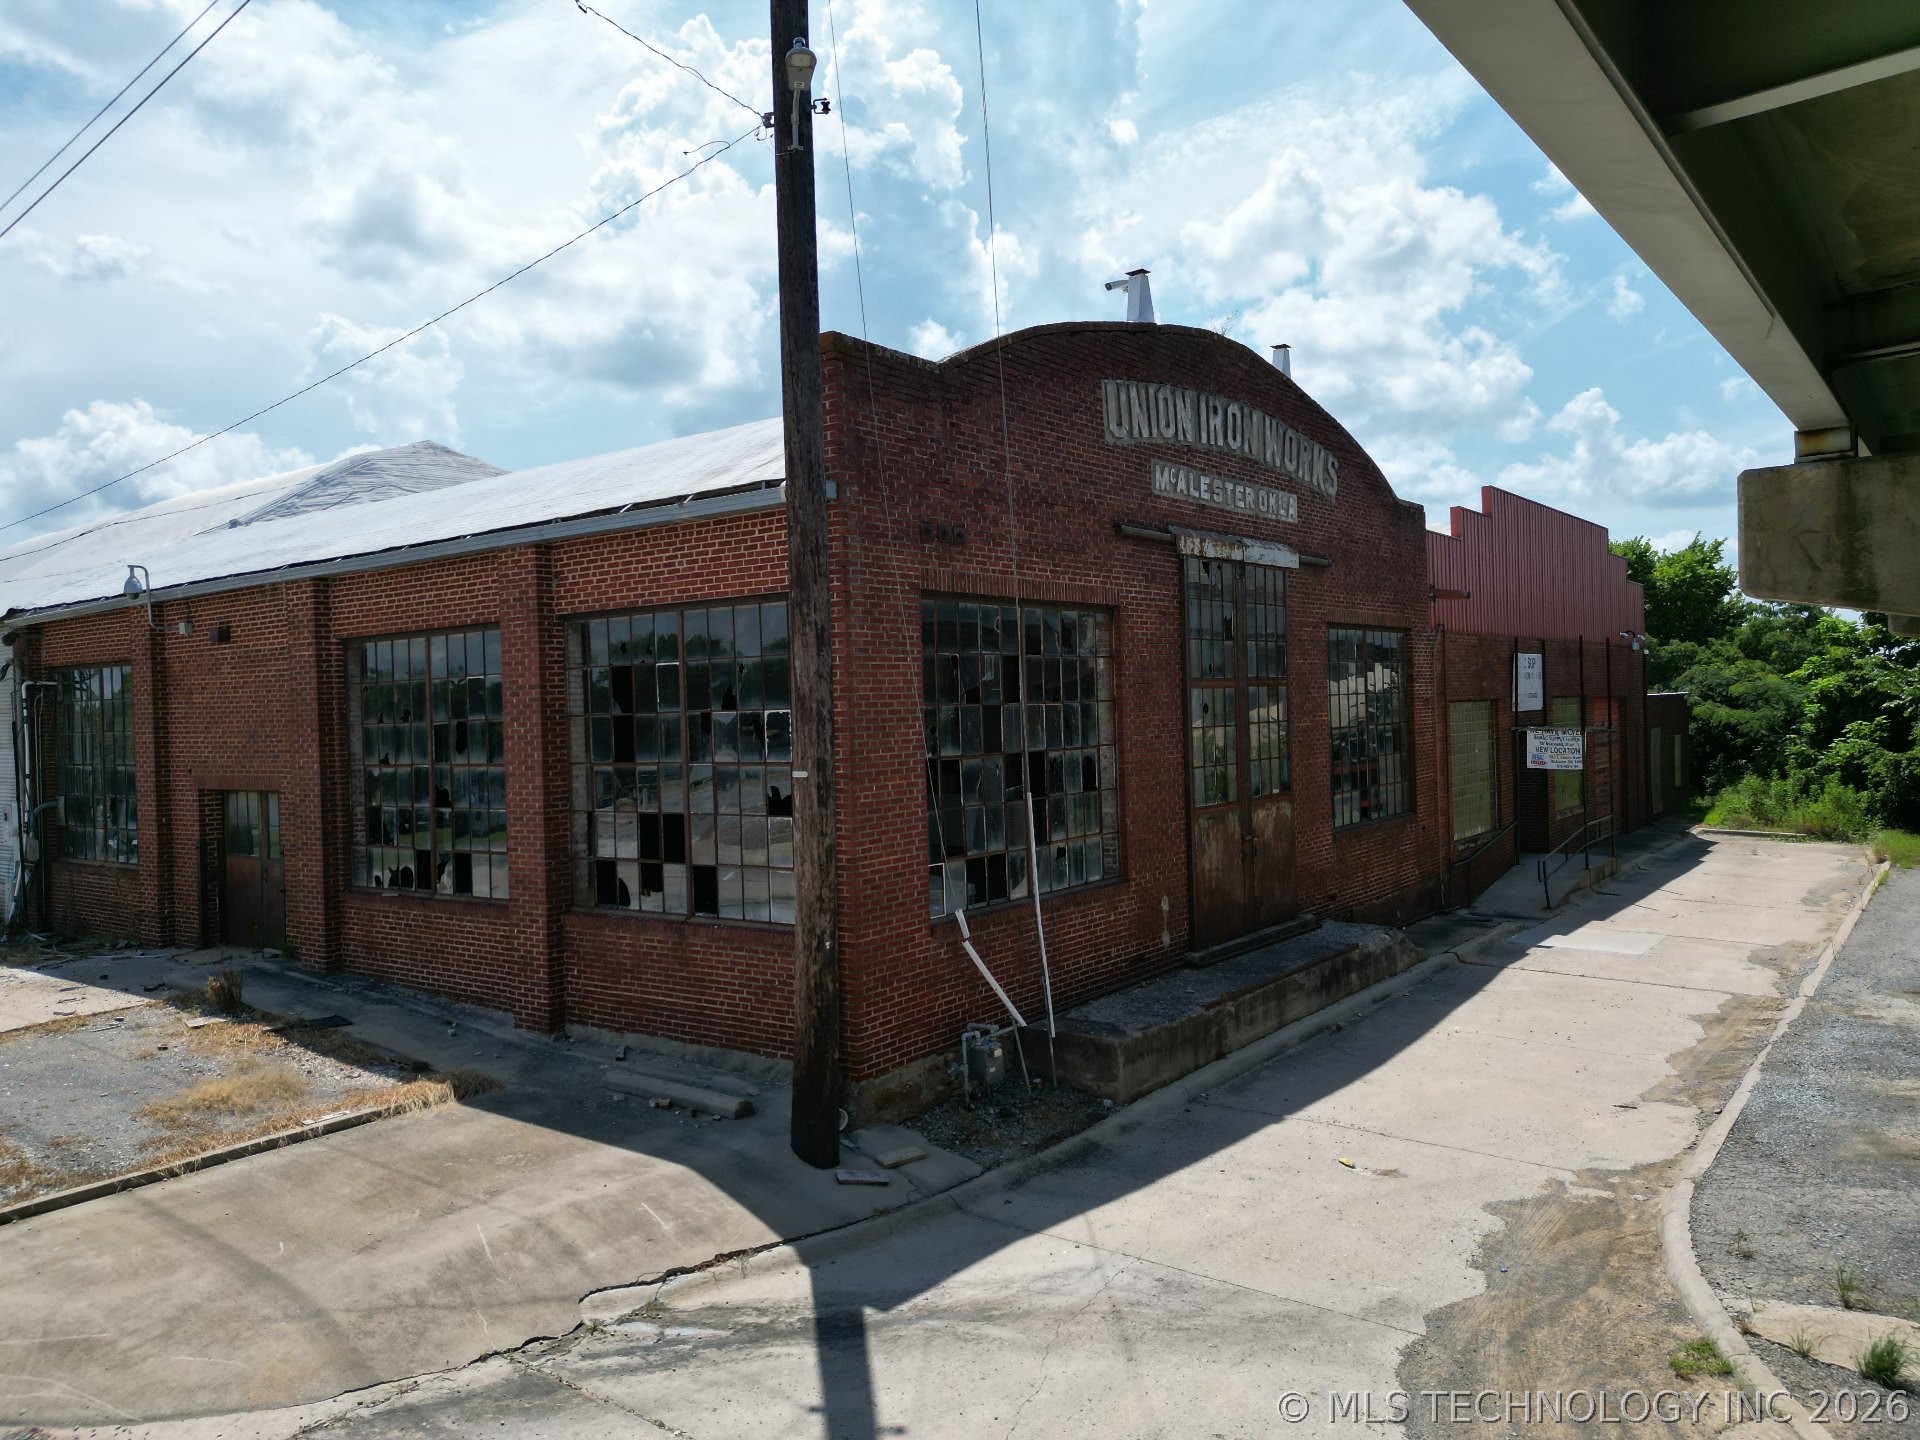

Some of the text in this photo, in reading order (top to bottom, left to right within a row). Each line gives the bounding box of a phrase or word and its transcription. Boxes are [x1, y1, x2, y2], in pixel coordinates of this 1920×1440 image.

[1105, 381, 1339, 498] UNION IRON WORKS
[1550, 747, 1581, 755] LOCATION
